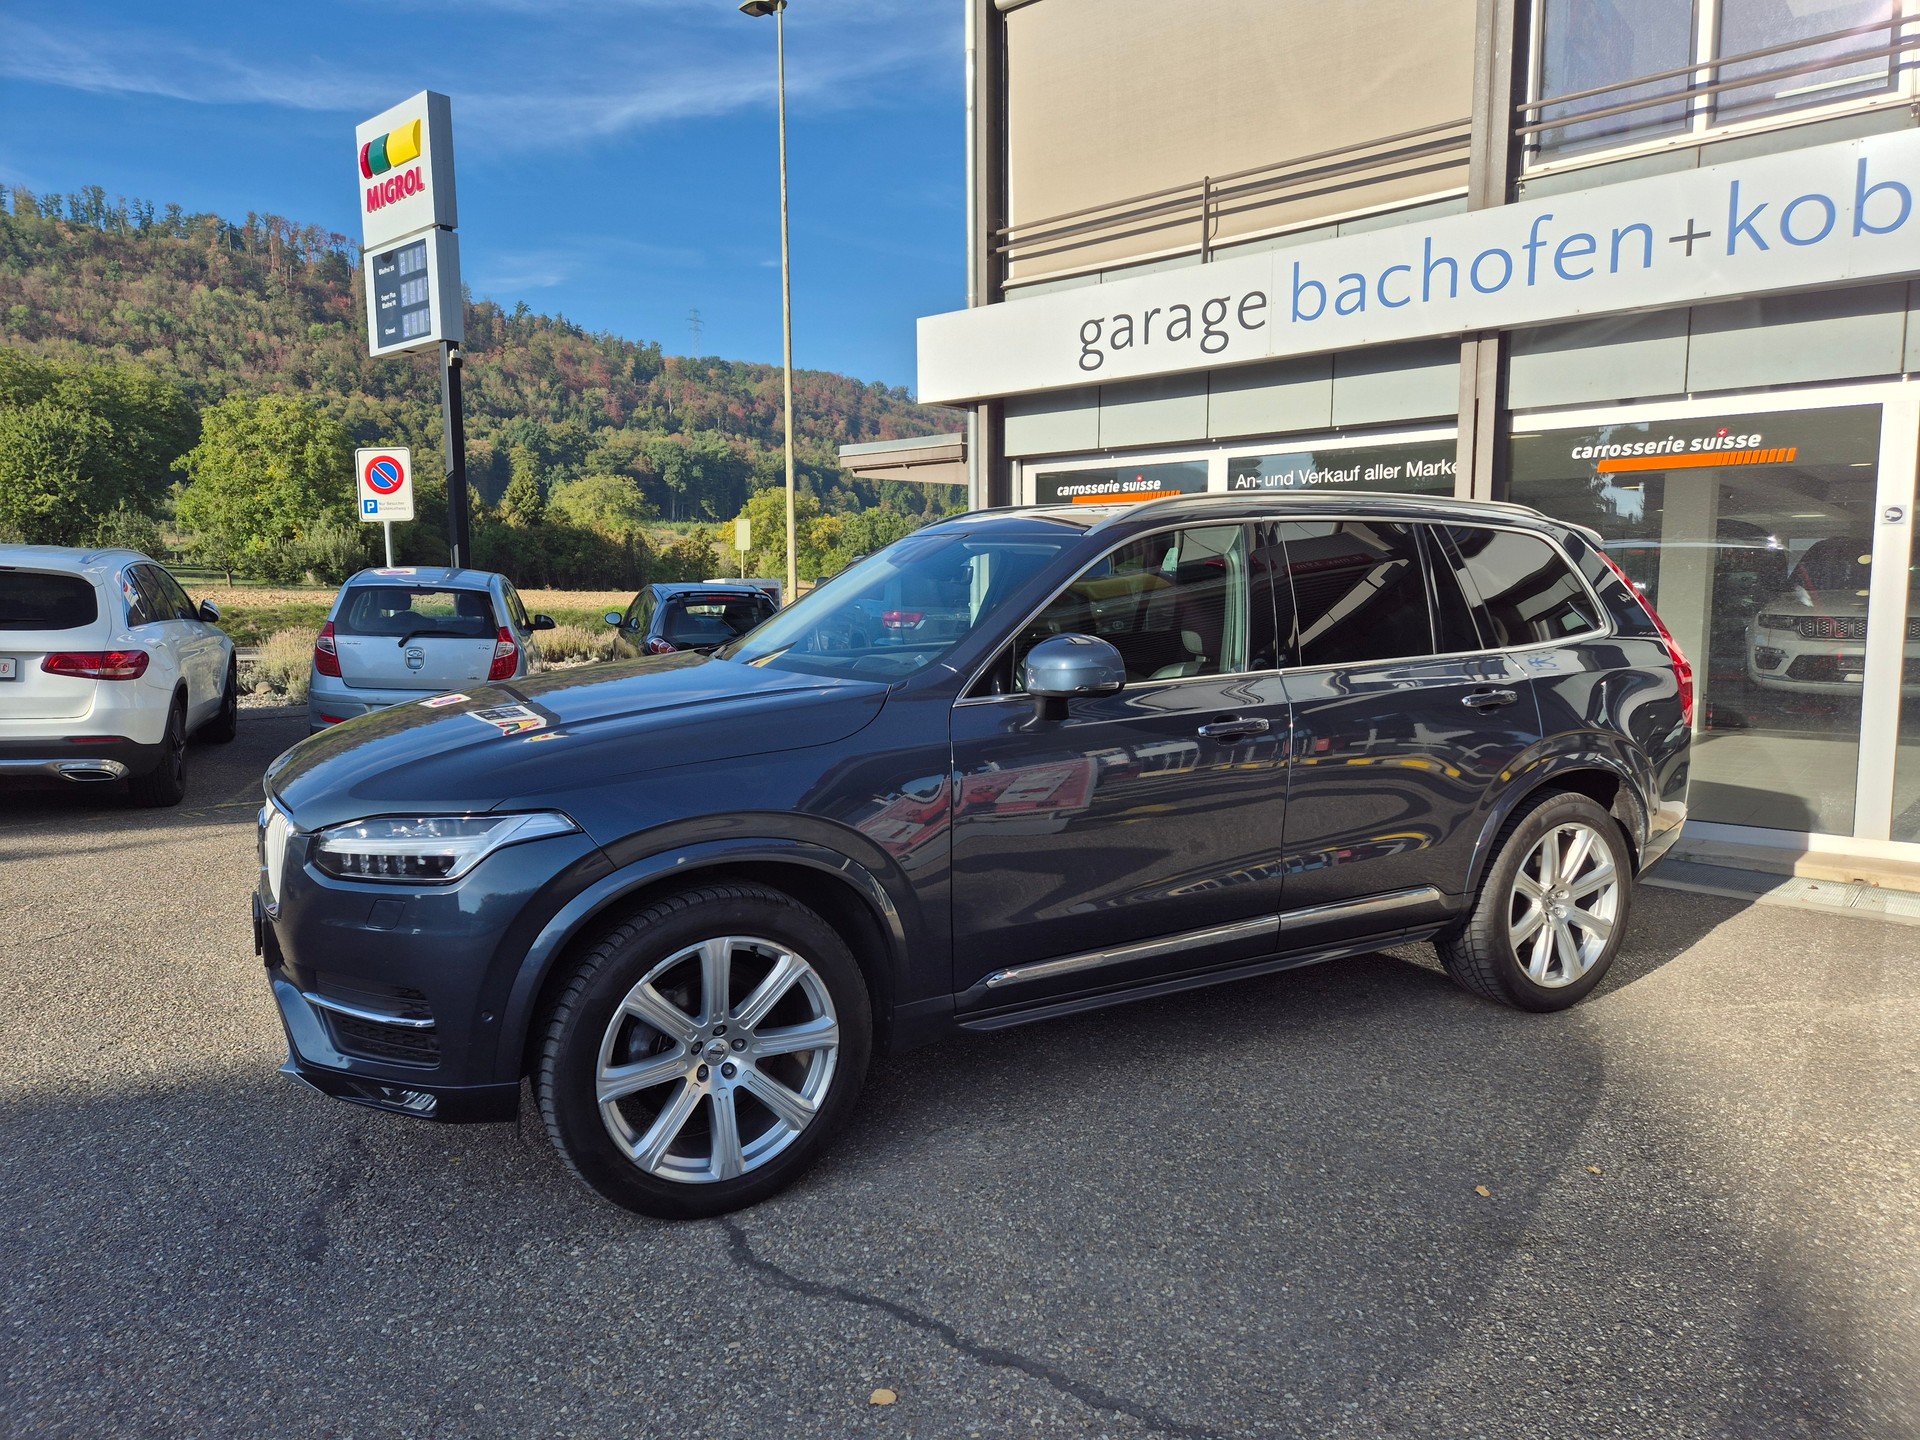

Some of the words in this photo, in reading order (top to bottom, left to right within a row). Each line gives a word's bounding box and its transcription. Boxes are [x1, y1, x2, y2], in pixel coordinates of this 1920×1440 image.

[366, 166, 426, 213] MIGROL
[1078, 290, 1268, 372] garage
[1571, 435, 1685, 460] carrosserie
[1689, 427, 1762, 452] suisse
[1056, 479, 1120, 496] carrosserie
[1121, 475, 1162, 492] suisse
[1235, 473, 1262, 489] An-
[1264, 470, 1294, 487] und
[1298, 464, 1362, 485] Verkauf
[1364, 465, 1402, 481] aller
[367, 502, 375, 512] P
